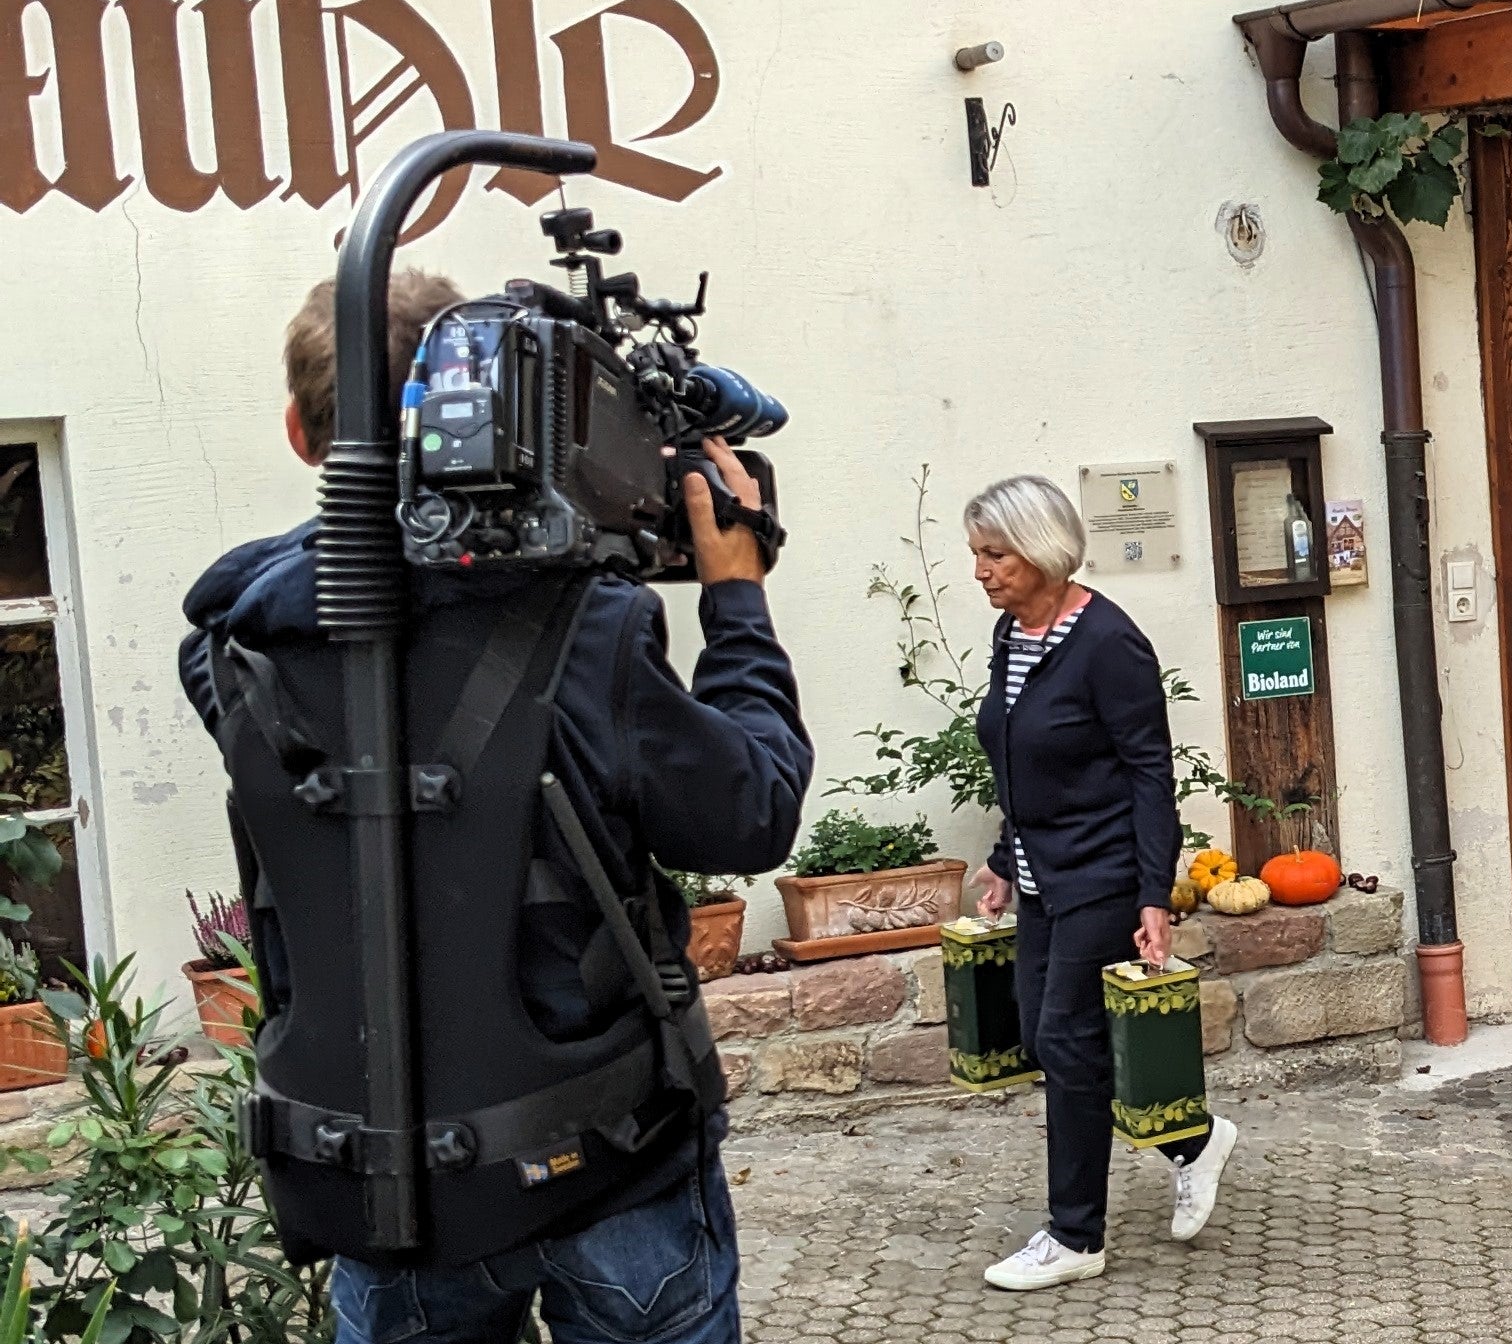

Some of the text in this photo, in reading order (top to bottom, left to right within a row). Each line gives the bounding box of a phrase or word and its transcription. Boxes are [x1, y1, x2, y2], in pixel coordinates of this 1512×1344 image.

[1257, 627, 1293, 641] Wir sind
[1251, 641, 1285, 654] Partner
[1247, 668, 1309, 693] Bioland
